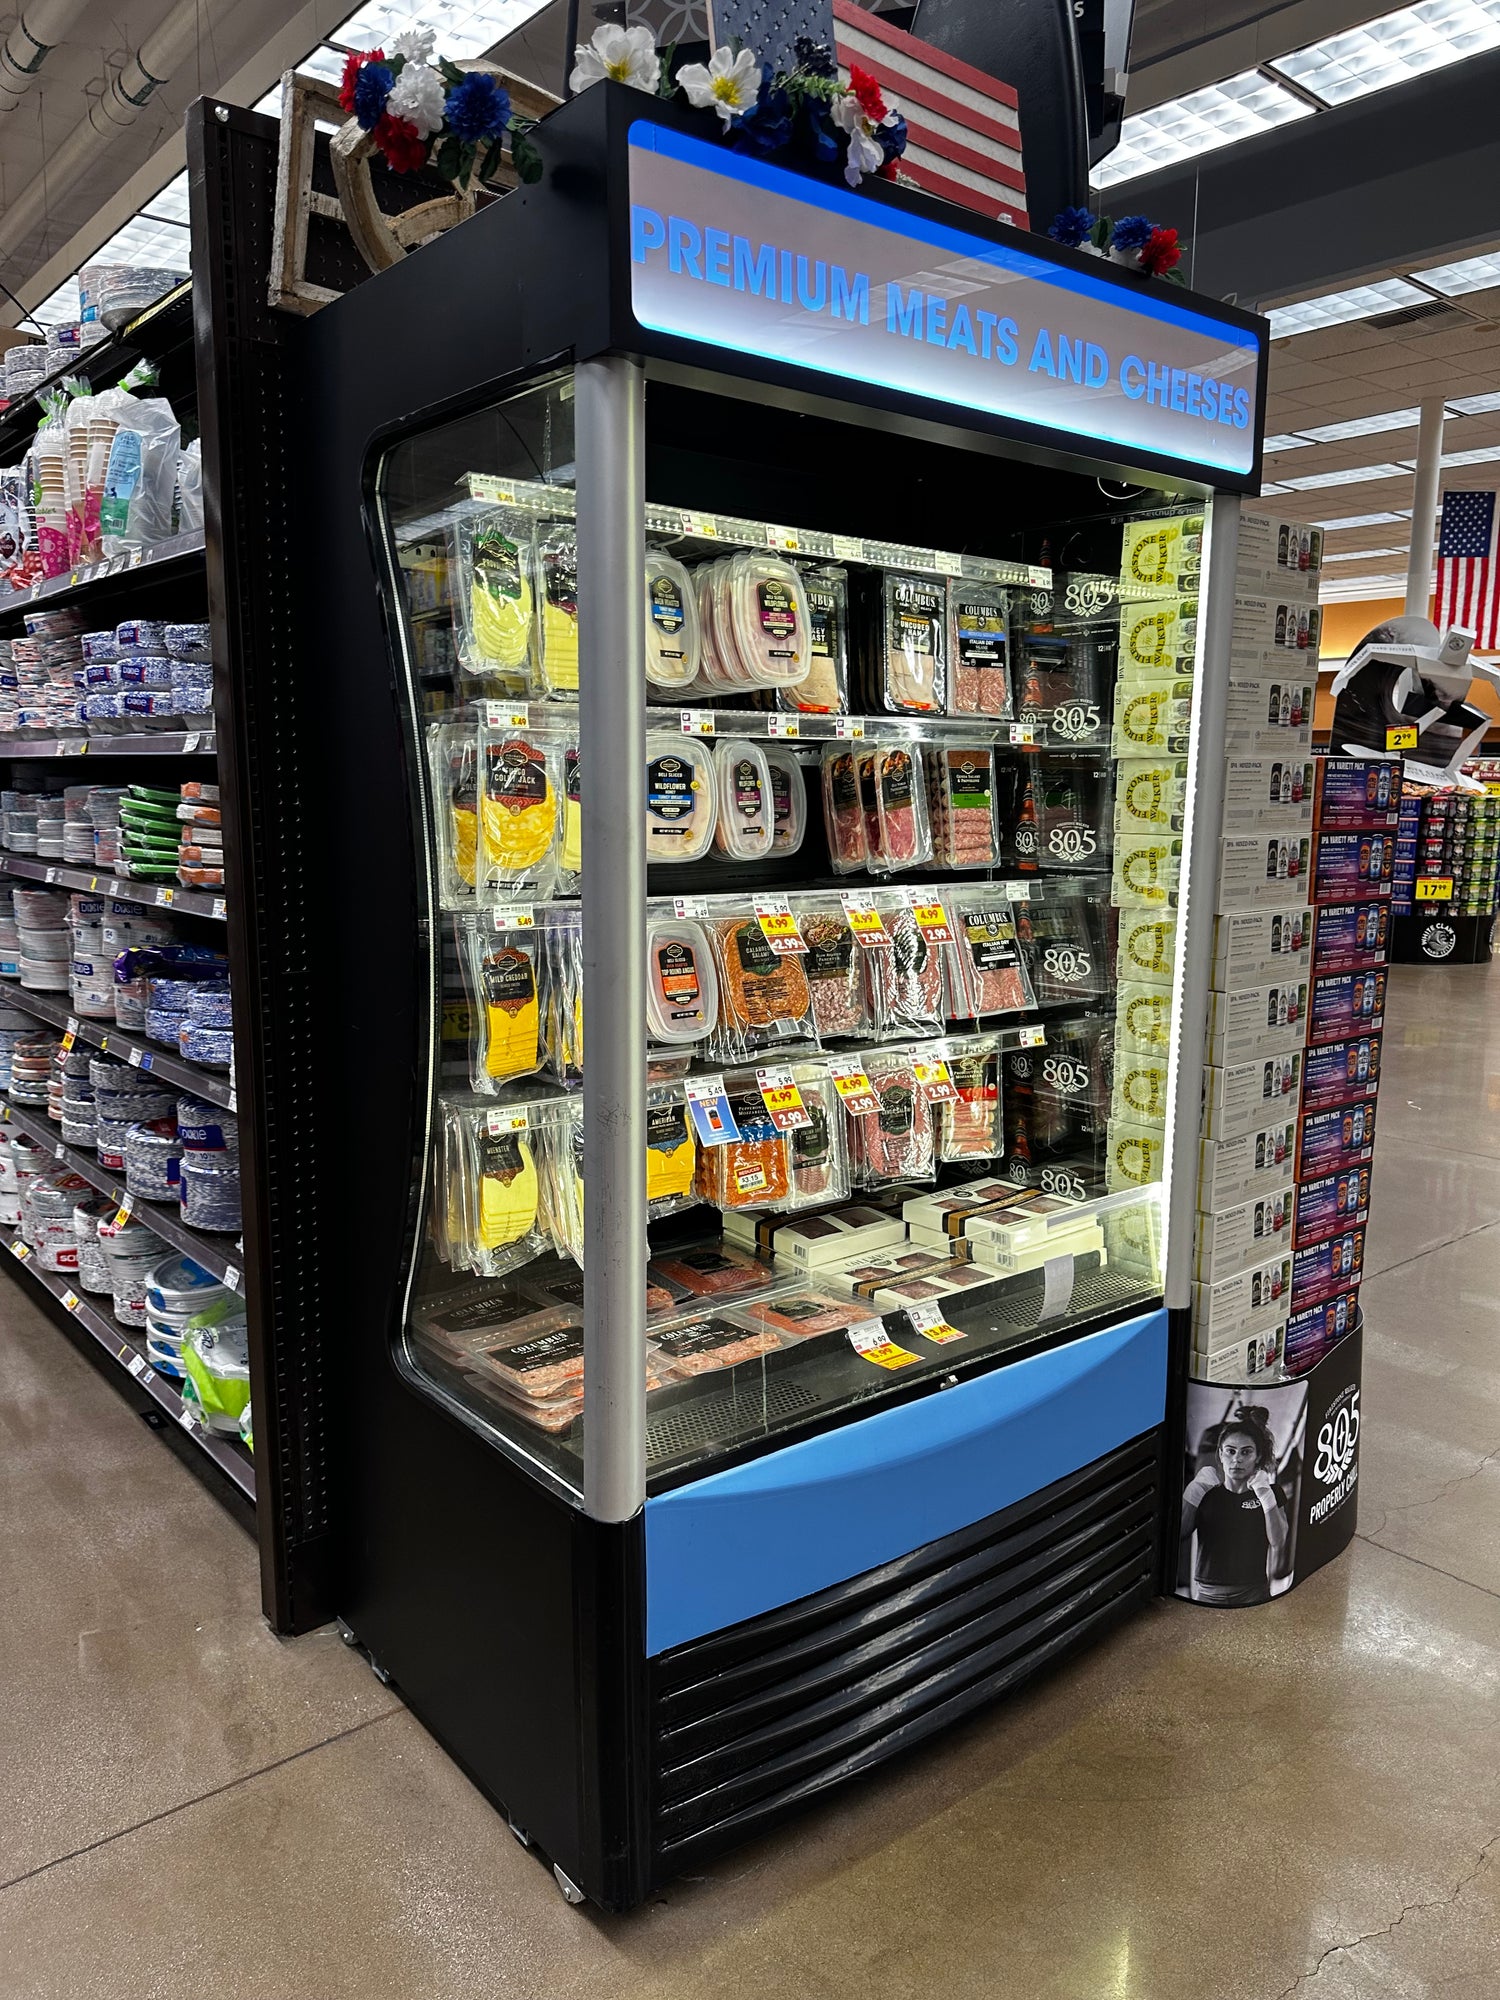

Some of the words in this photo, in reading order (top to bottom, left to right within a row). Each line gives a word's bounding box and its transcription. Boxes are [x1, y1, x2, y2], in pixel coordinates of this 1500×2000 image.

[632, 205, 871, 325] PREMIUM
[886, 283, 1019, 366] MEATS
[1029, 329, 1110, 389] AND
[1120, 355, 1250, 429] CHEESES
[1065, 580, 1113, 610] 805
[965, 605, 998, 617] COLUMBUS
[511, 717, 527, 726] 5.49
[1053, 705, 1100, 734] 805
[1336, 761, 1354, 771] VARIETY
[1353, 762, 1365, 771] PACK
[1015, 831, 1040, 849] 805
[1048, 829, 1097, 854] 805
[854, 914, 873, 925] 4.99
[921, 909, 938, 920] 4.99
[968, 912, 1008, 926] COLUMBUS
[518, 917, 533, 926] 5.49
[767, 918, 788, 929] 4.99
[927, 928, 947, 940] 2.99
[1436, 922, 1455, 935] CLAW
[863, 931, 884, 943] 2.99
[777, 938, 799, 950] 2.99
[1044, 949, 1091, 973] 805
[1043, 1058, 1089, 1089] 805
[777, 1076, 792, 1085] 5.99
[842, 1079, 862, 1090] 4.99
[708, 1086, 723, 1096] 5.49
[771, 1091, 792, 1103] 4.99
[929, 1085, 950, 1098] 2.99
[699, 1098, 718, 1108] NEW
[851, 1098, 874, 1111] 2.99
[511, 1119, 527, 1128] 5.49
[779, 1111, 802, 1126] 2.99
[741, 1174, 759, 1185] $3.15
[1041, 1169, 1087, 1200] 805
[660, 1323, 712, 1341] COLUMBUS
[923, 1324, 953, 1338] 13.49
[510, 1332, 569, 1355] COLUMBUS
[872, 1334, 887, 1347] 6.99
[869, 1347, 894, 1359] 5.99
[1314, 1389, 1360, 1480] 805
[1310, 1478, 1346, 1525] PROPERLY
